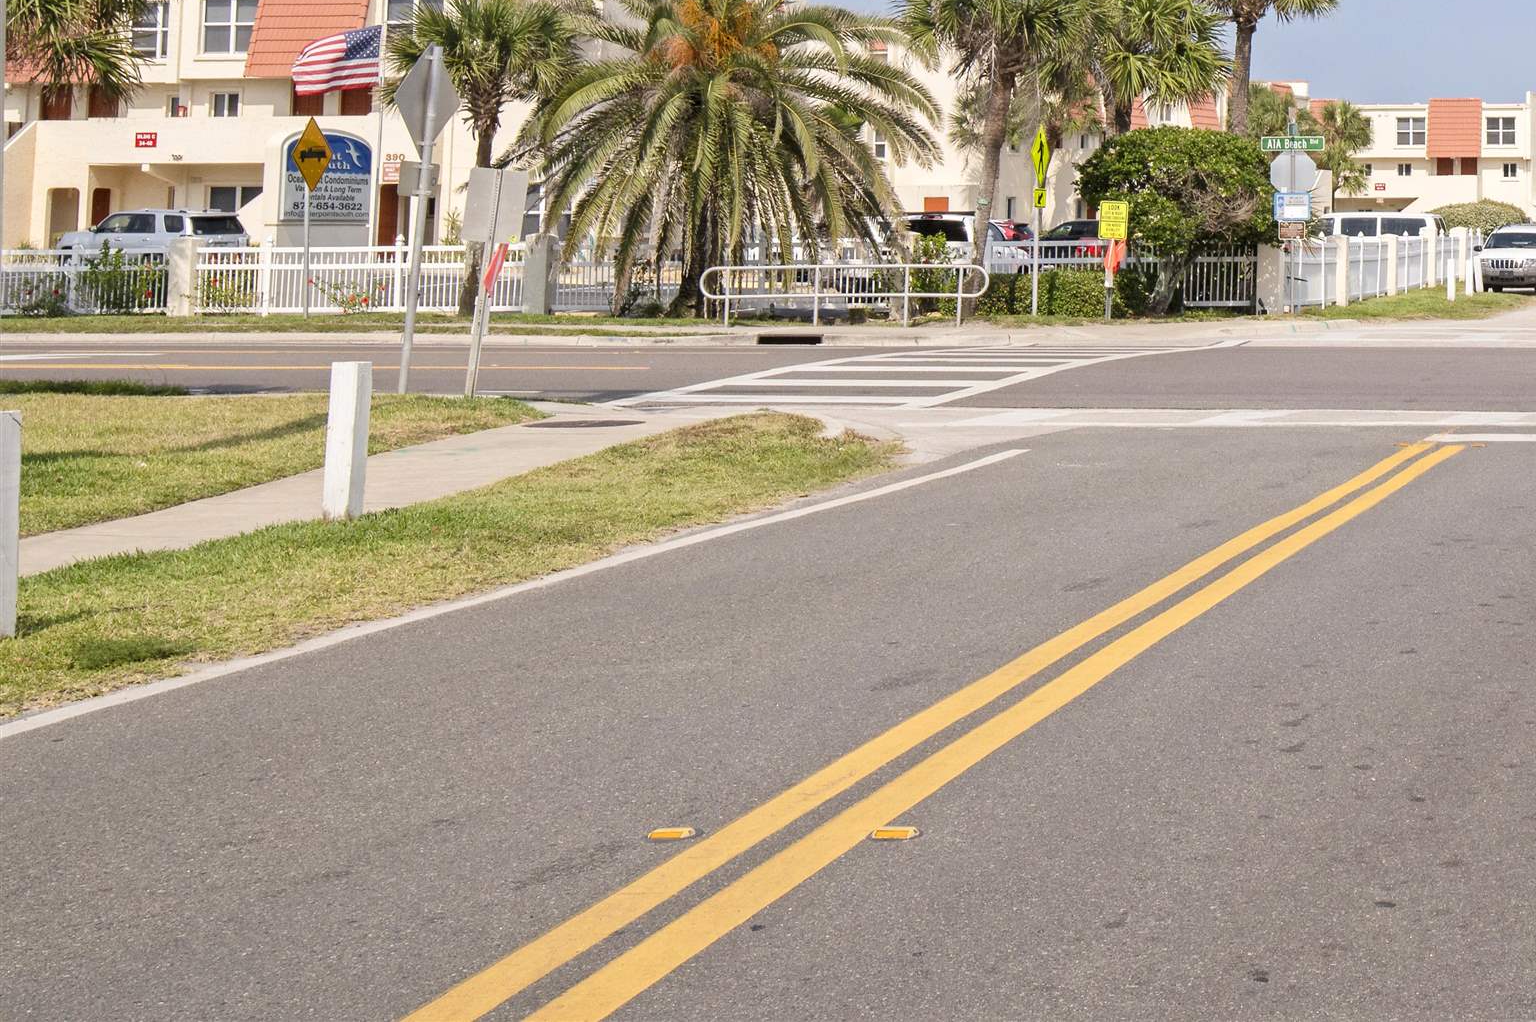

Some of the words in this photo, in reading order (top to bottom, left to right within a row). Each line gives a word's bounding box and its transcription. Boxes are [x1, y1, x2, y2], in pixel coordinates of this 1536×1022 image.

[1267, 138, 1281, 149] A1A
[1284, 138, 1307, 149] Beach
[385, 153, 406, 162] 390
[324, 175, 369, 186] Condominiums
[330, 185, 346, 194] Long
